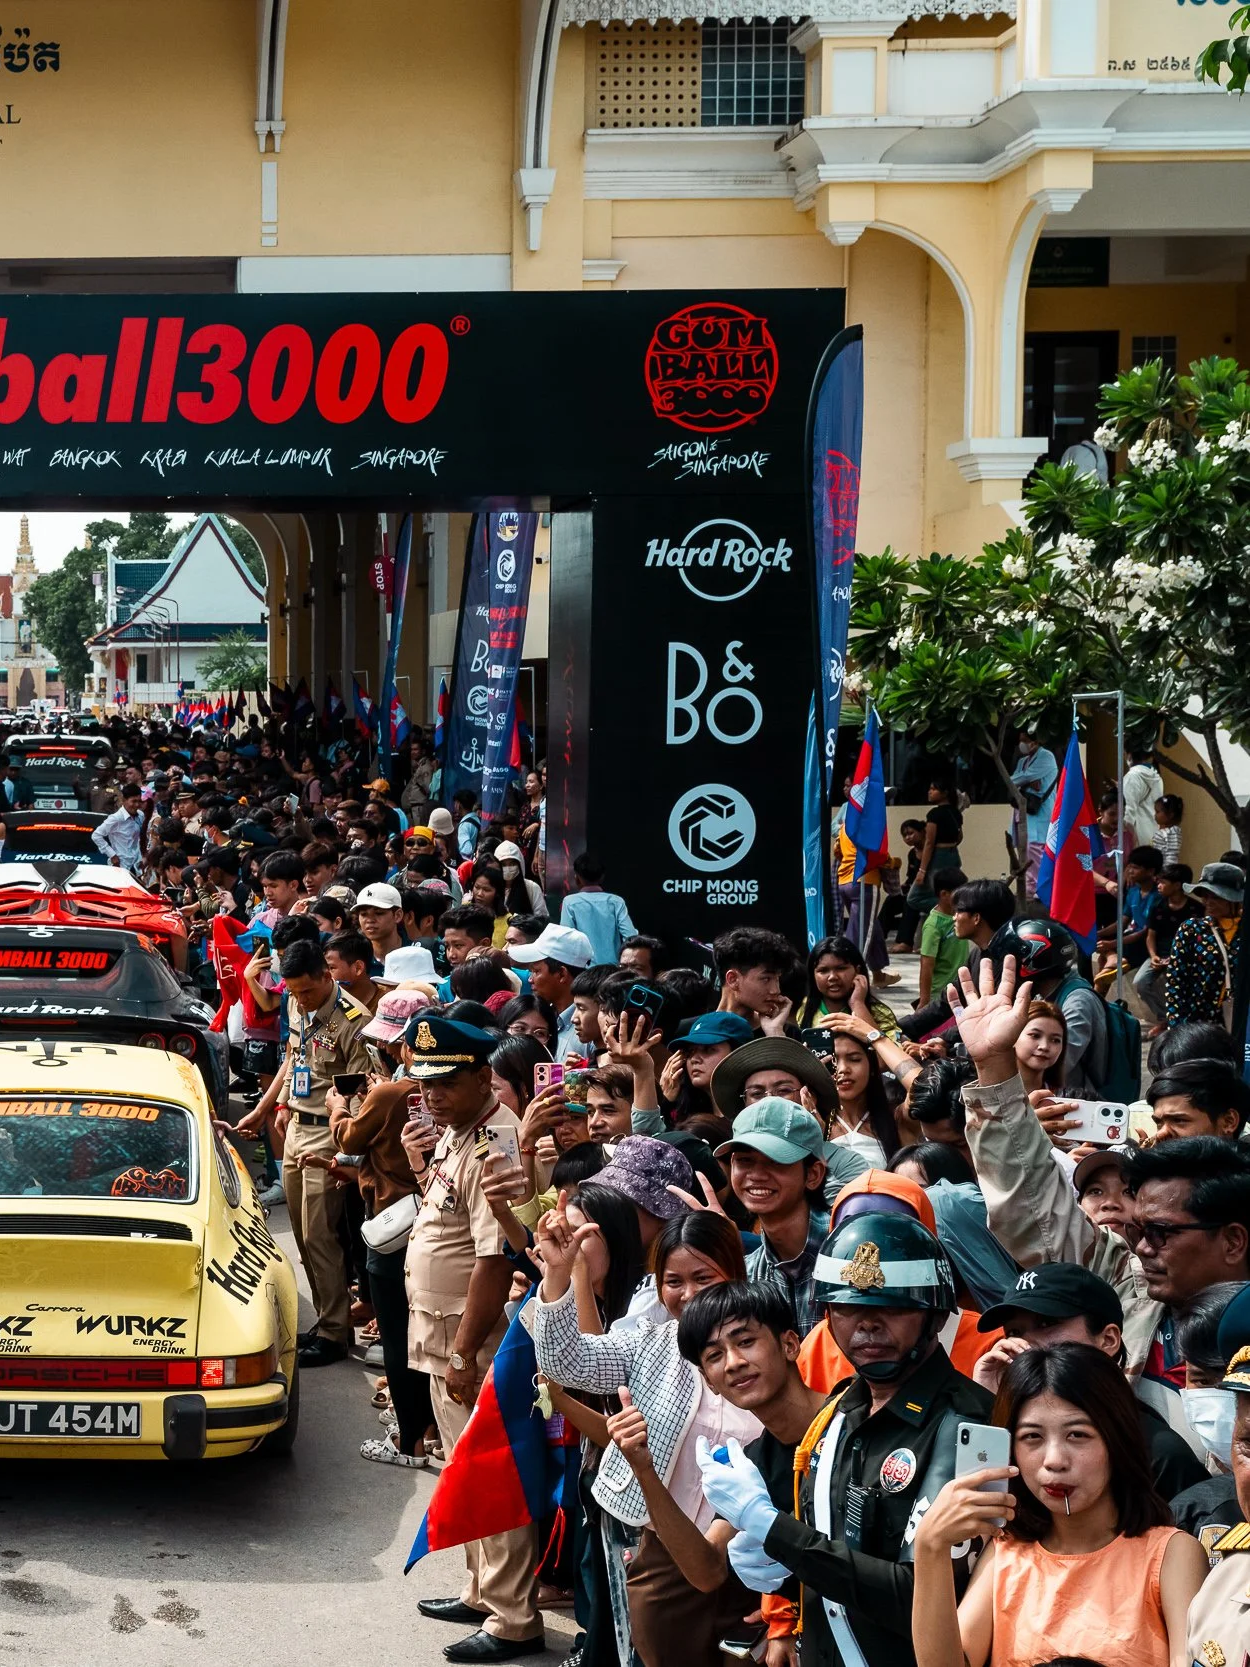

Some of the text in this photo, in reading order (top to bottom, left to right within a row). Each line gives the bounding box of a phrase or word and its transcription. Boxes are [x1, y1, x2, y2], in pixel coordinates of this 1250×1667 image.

[655, 315, 771, 352] GUM
[652, 351, 770, 386] BALL
[653, 383, 770, 418] 3000
[3, 448, 31, 466] WAT
[50, 448, 121, 470] BANGKOK
[205, 449, 260, 467] KUALA
[265, 448, 333, 476] LUMPUR
[351, 448, 445, 476] SINGAPORE
[648, 439, 710, 468] SAIGON
[673, 450, 768, 480] SINGAPORE
[644, 537, 794, 574] Hard Rock
[374, 562, 385, 591] STOP
[25, 757, 86, 768] Hard Rock
[14, 853, 92, 863] Hard Rock
[663, 880, 758, 895] CHIP MONG
[707, 894, 758, 904] GROUP
[56, 951, 109, 969] 3000
[37, 1004, 110, 1016] Rock
[78, 1102, 160, 1122] 3000
[205, 1229, 268, 1305] Hard
[24, 1302, 87, 1313] Carrera
[75, 1315, 188, 1339] WURKZ
[132, 1338, 177, 1348] ENERGY
[152, 1346, 187, 1355] DRINK
[47, 1404, 141, 1436] 454M
